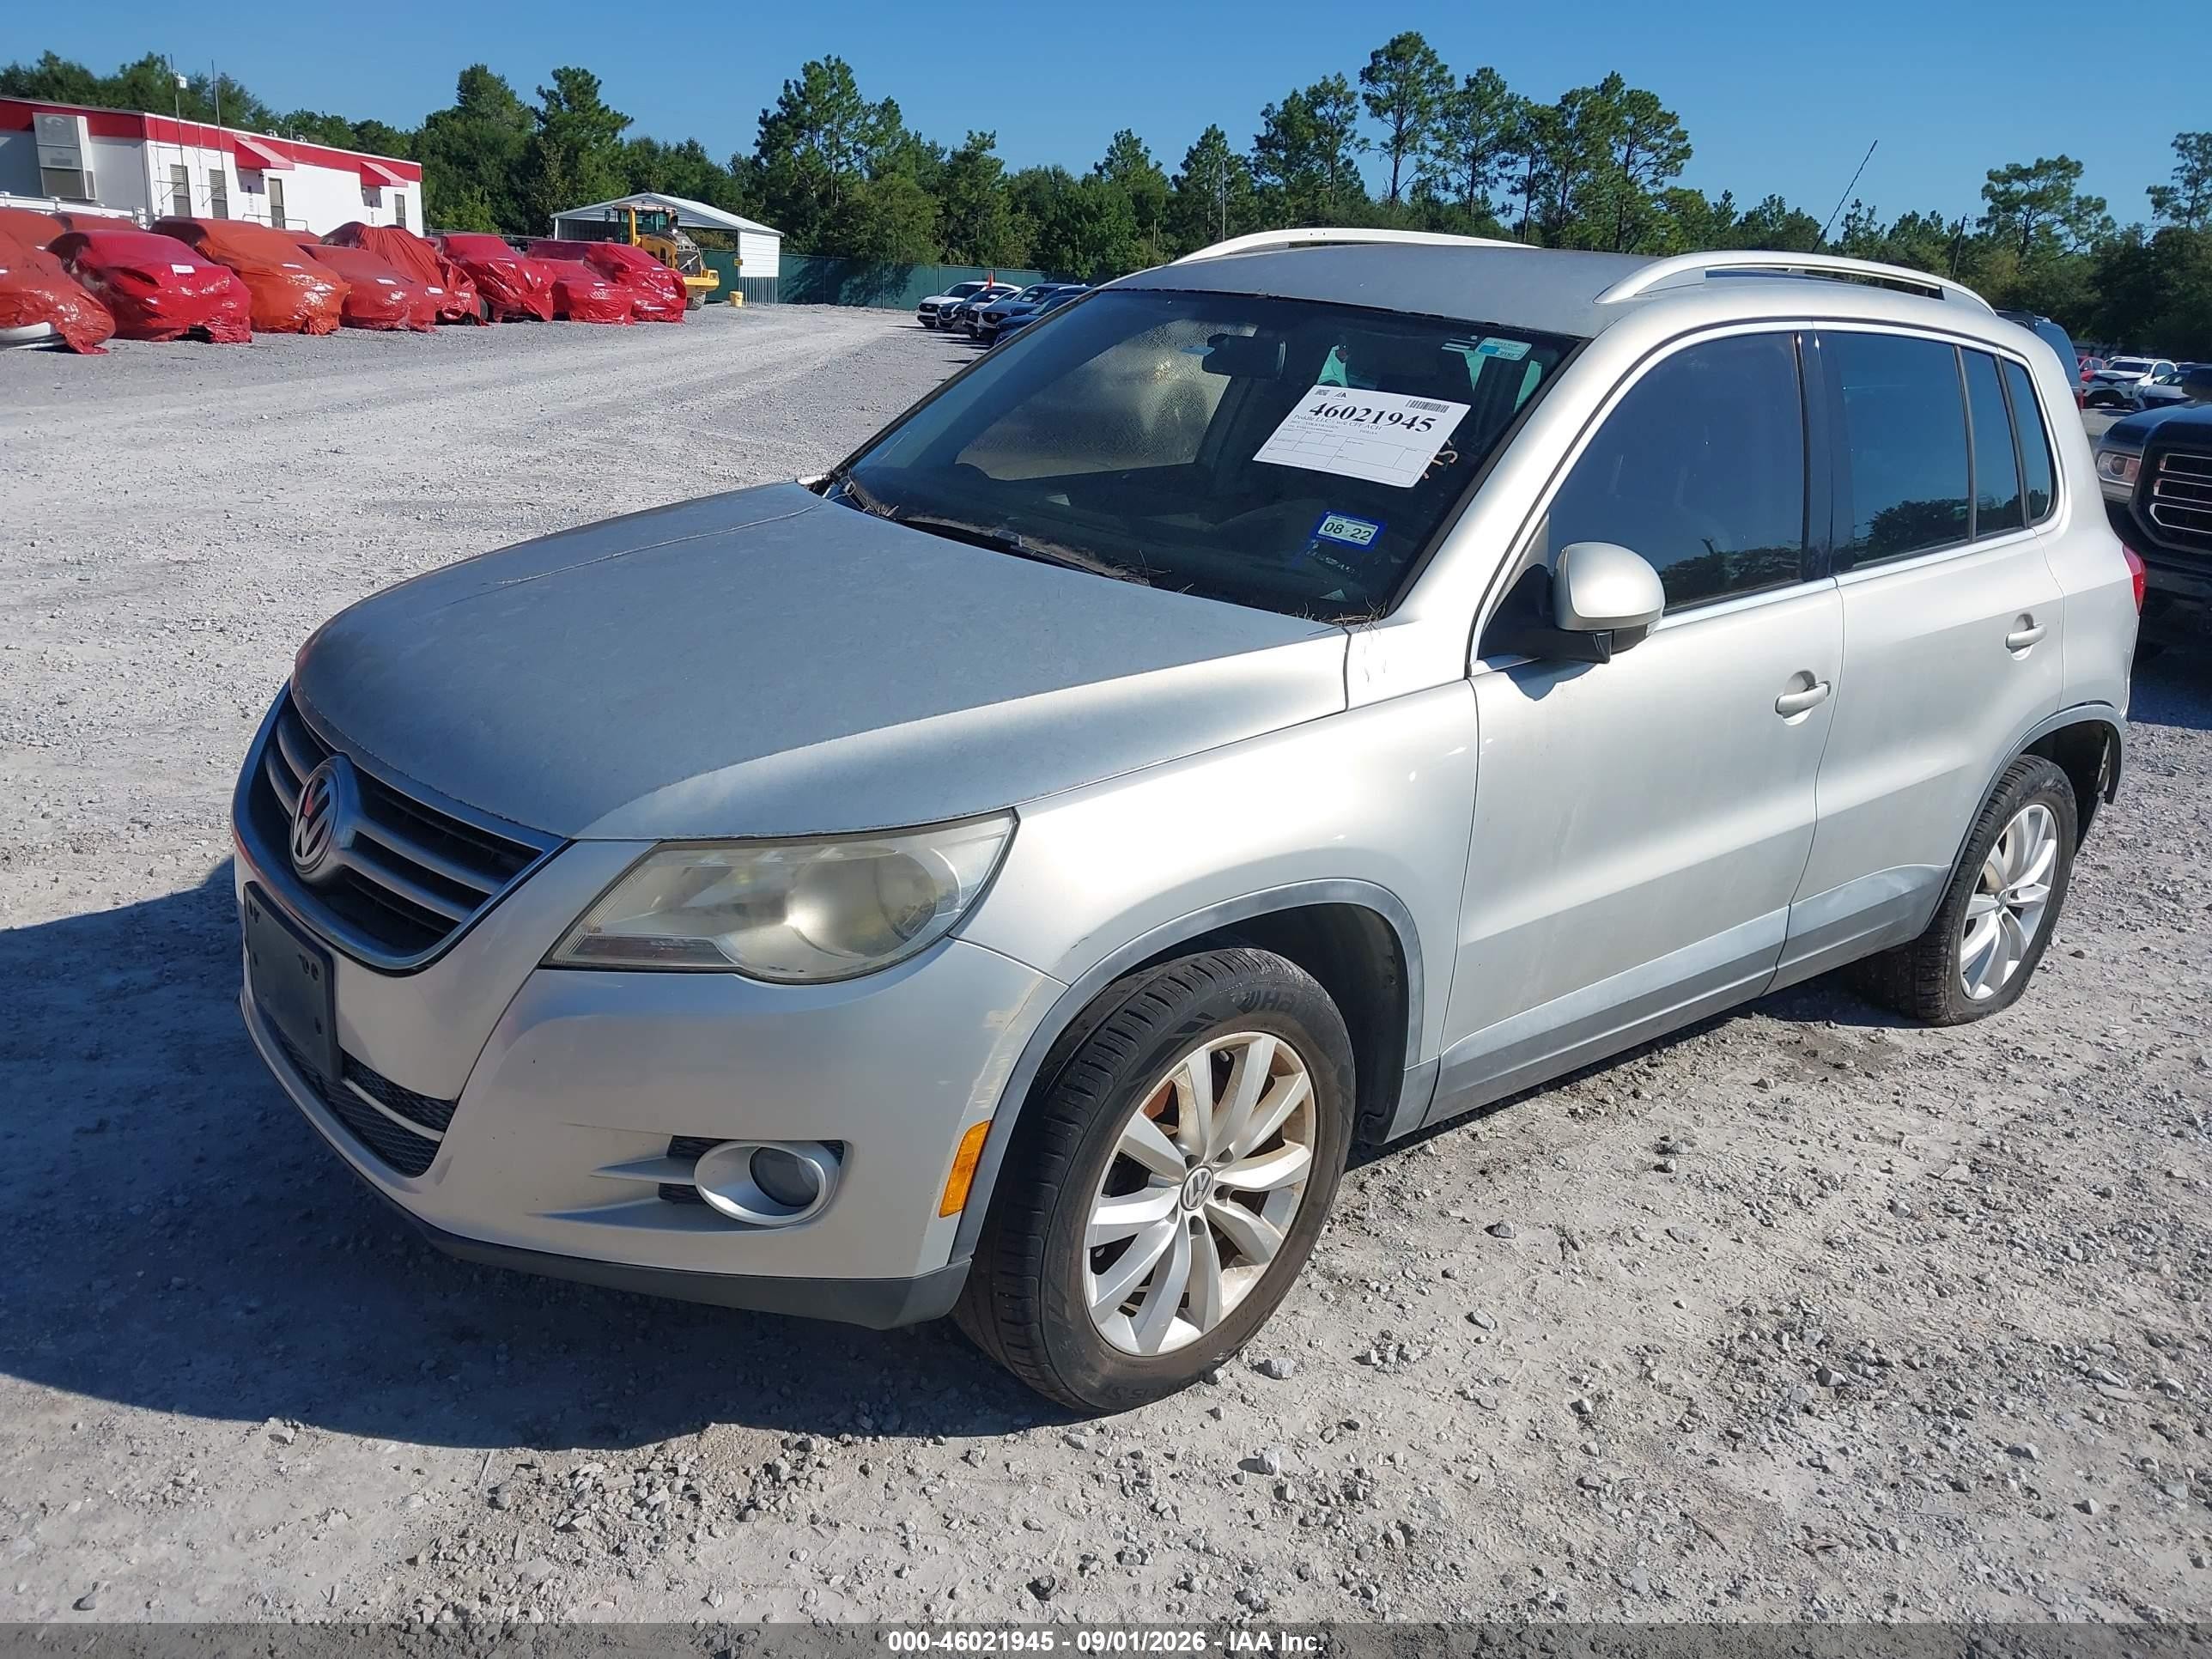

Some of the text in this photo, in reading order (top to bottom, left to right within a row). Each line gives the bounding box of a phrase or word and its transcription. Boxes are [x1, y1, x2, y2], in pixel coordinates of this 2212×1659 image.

[1309, 402, 1437, 433] 46021945
[1323, 522, 1345, 534] 08
[1349, 528, 1372, 541] 22
